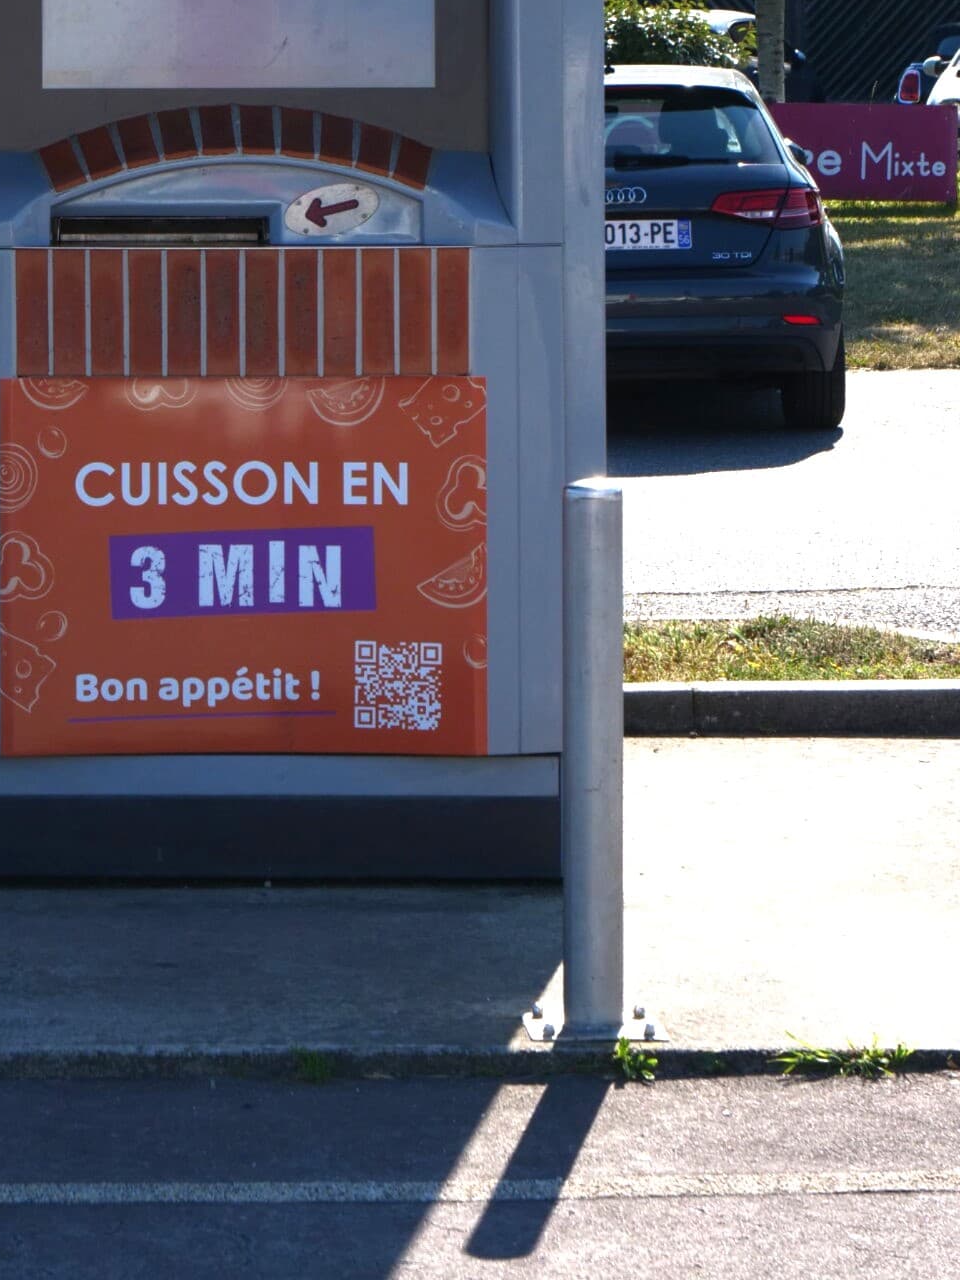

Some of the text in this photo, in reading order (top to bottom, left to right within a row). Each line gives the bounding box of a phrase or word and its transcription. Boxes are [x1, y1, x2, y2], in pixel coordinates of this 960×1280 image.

[860, 141, 947, 180] Mixte
[605, 222, 675, 244] 013-PE
[74, 460, 409, 506] CUISSON EN
[129, 540, 342, 609] 3 MIN
[75, 673, 148, 702] Bon
[158, 667, 300, 707] appétit
